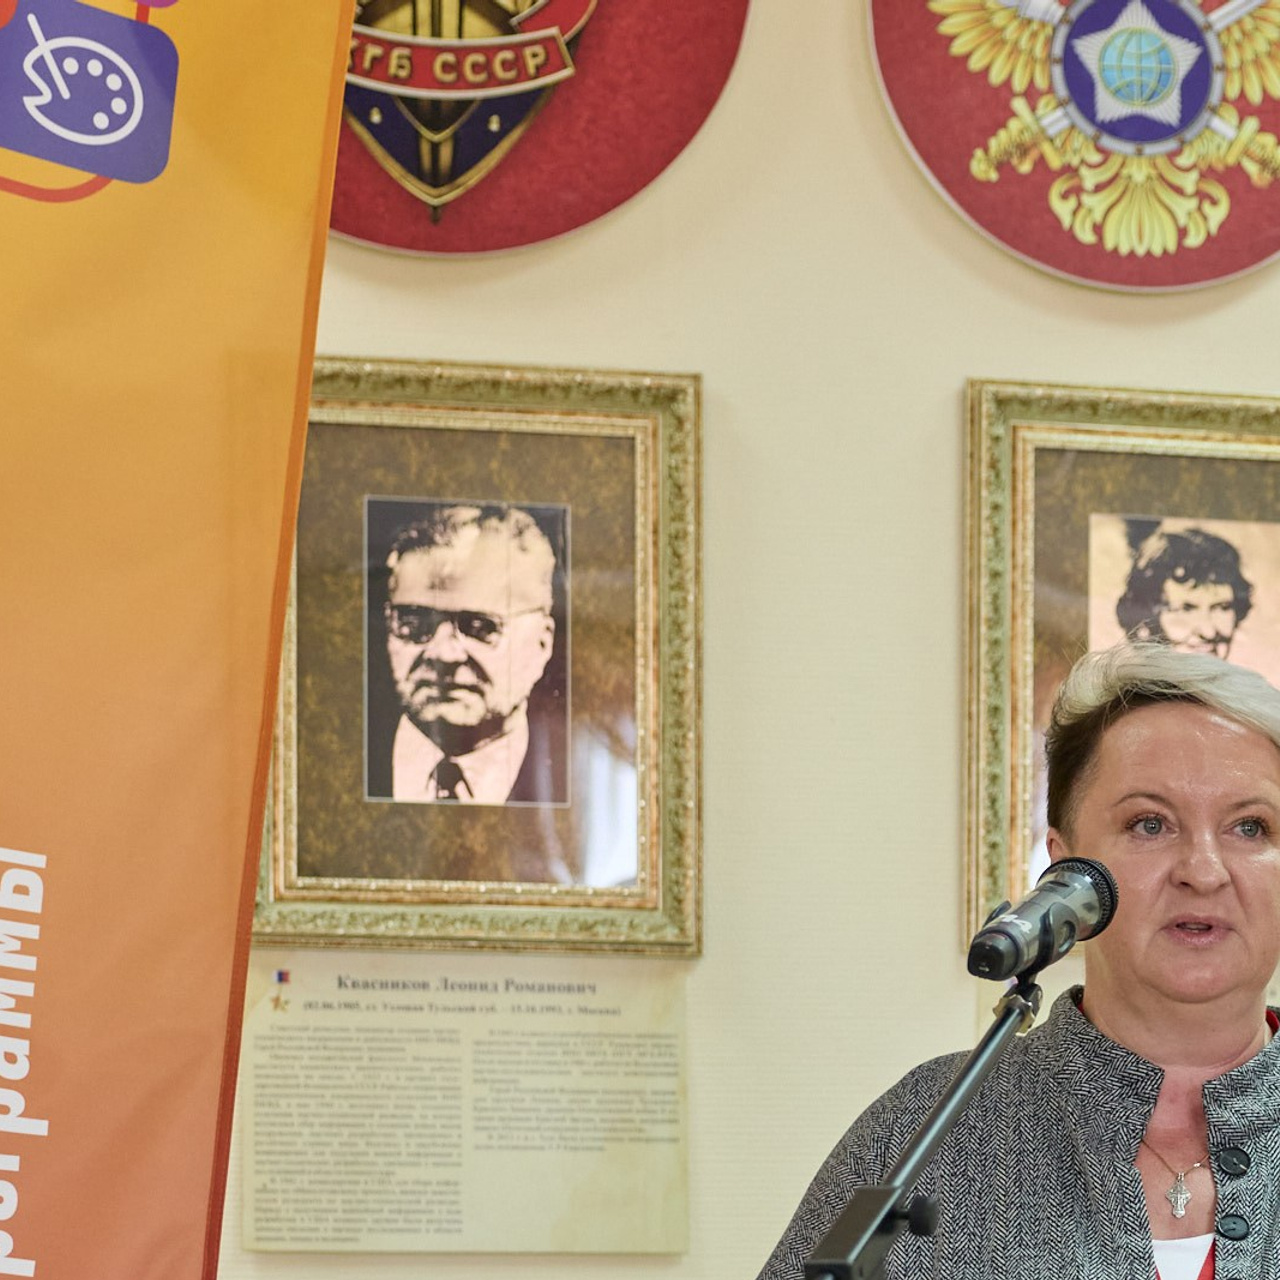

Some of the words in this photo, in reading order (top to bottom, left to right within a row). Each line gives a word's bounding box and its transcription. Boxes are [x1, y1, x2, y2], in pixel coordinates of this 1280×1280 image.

[433, 45, 547, 83] СССР
[337, 974, 431, 993] Квасников
[435, 976, 499, 995] Леонид
[504, 977, 598, 996] Романович
